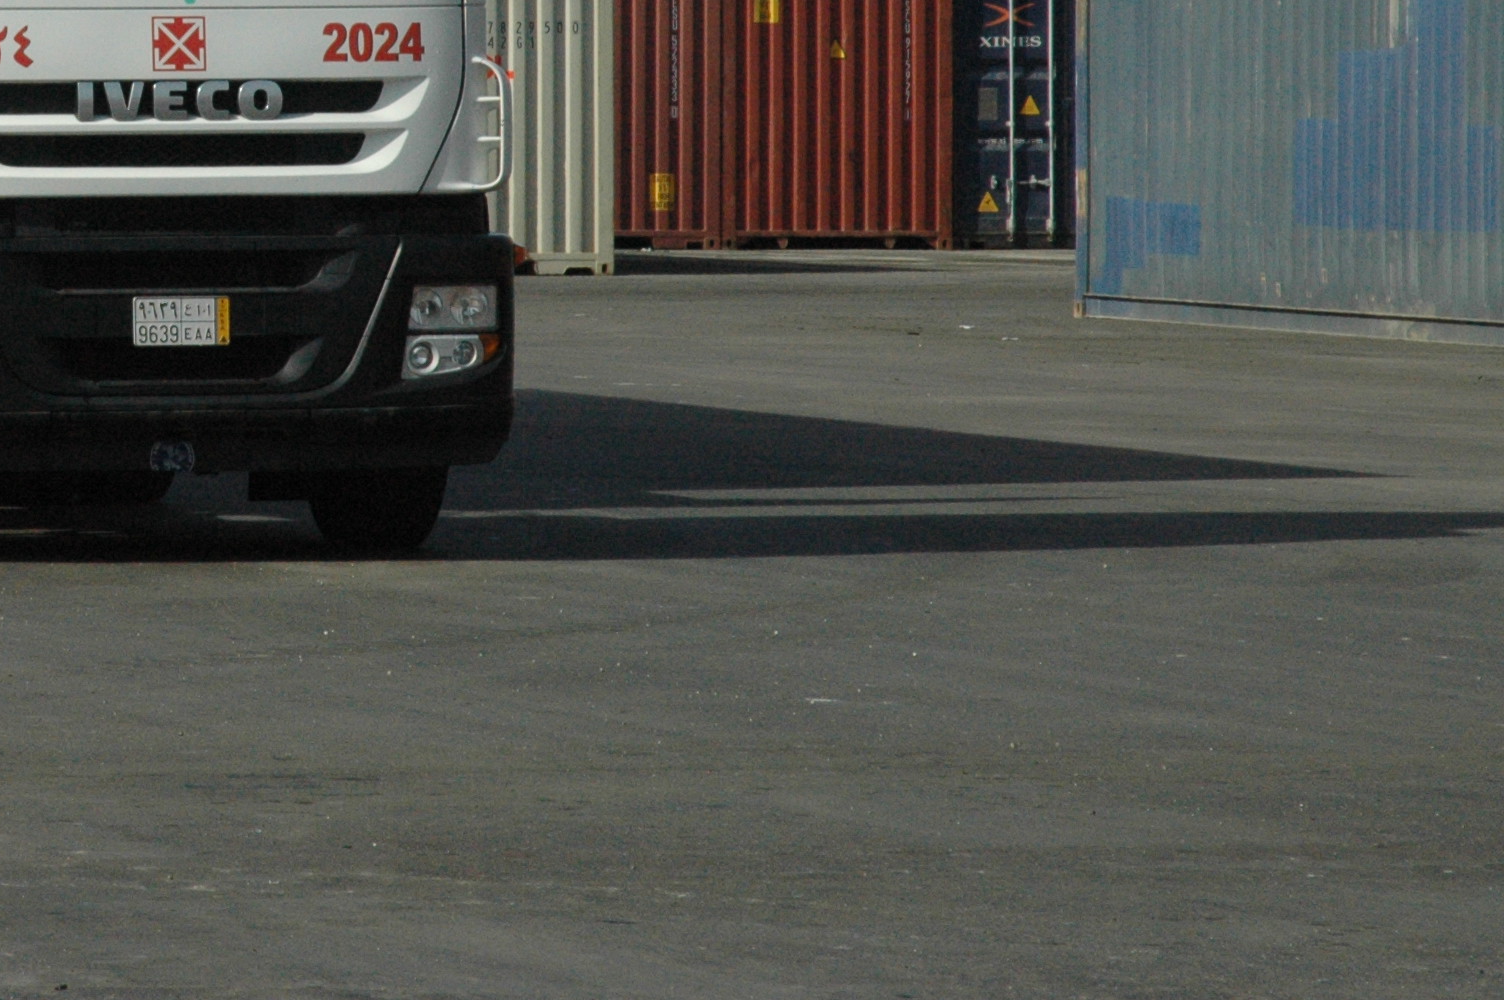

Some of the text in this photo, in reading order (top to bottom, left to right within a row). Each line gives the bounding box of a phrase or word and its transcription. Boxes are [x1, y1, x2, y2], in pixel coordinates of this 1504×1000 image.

[322, 22, 425, 62] 2024
[76, 80, 284, 122] IVECO
[138, 324, 179, 344] 9639
